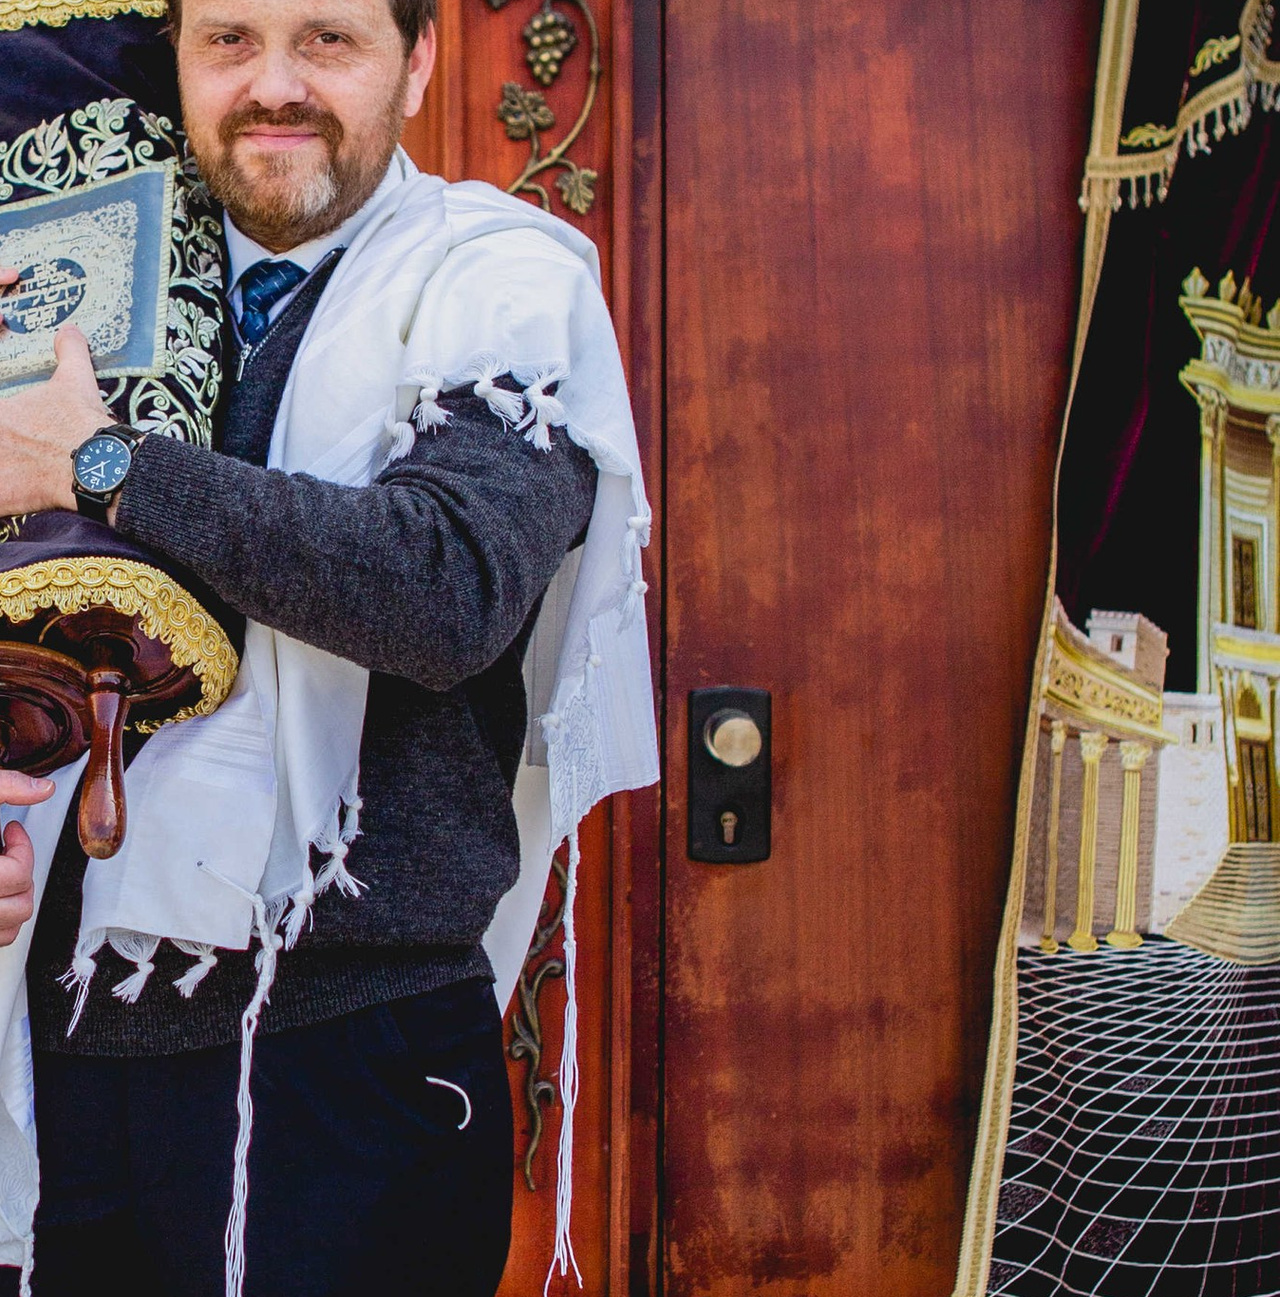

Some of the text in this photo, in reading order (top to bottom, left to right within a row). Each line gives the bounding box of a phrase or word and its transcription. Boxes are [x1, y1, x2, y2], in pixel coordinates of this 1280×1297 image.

[106, 445, 114, 453] 6
[83, 455, 91, 463] 3
[114, 467, 122, 475] 9
[90, 476, 100, 486] 12
